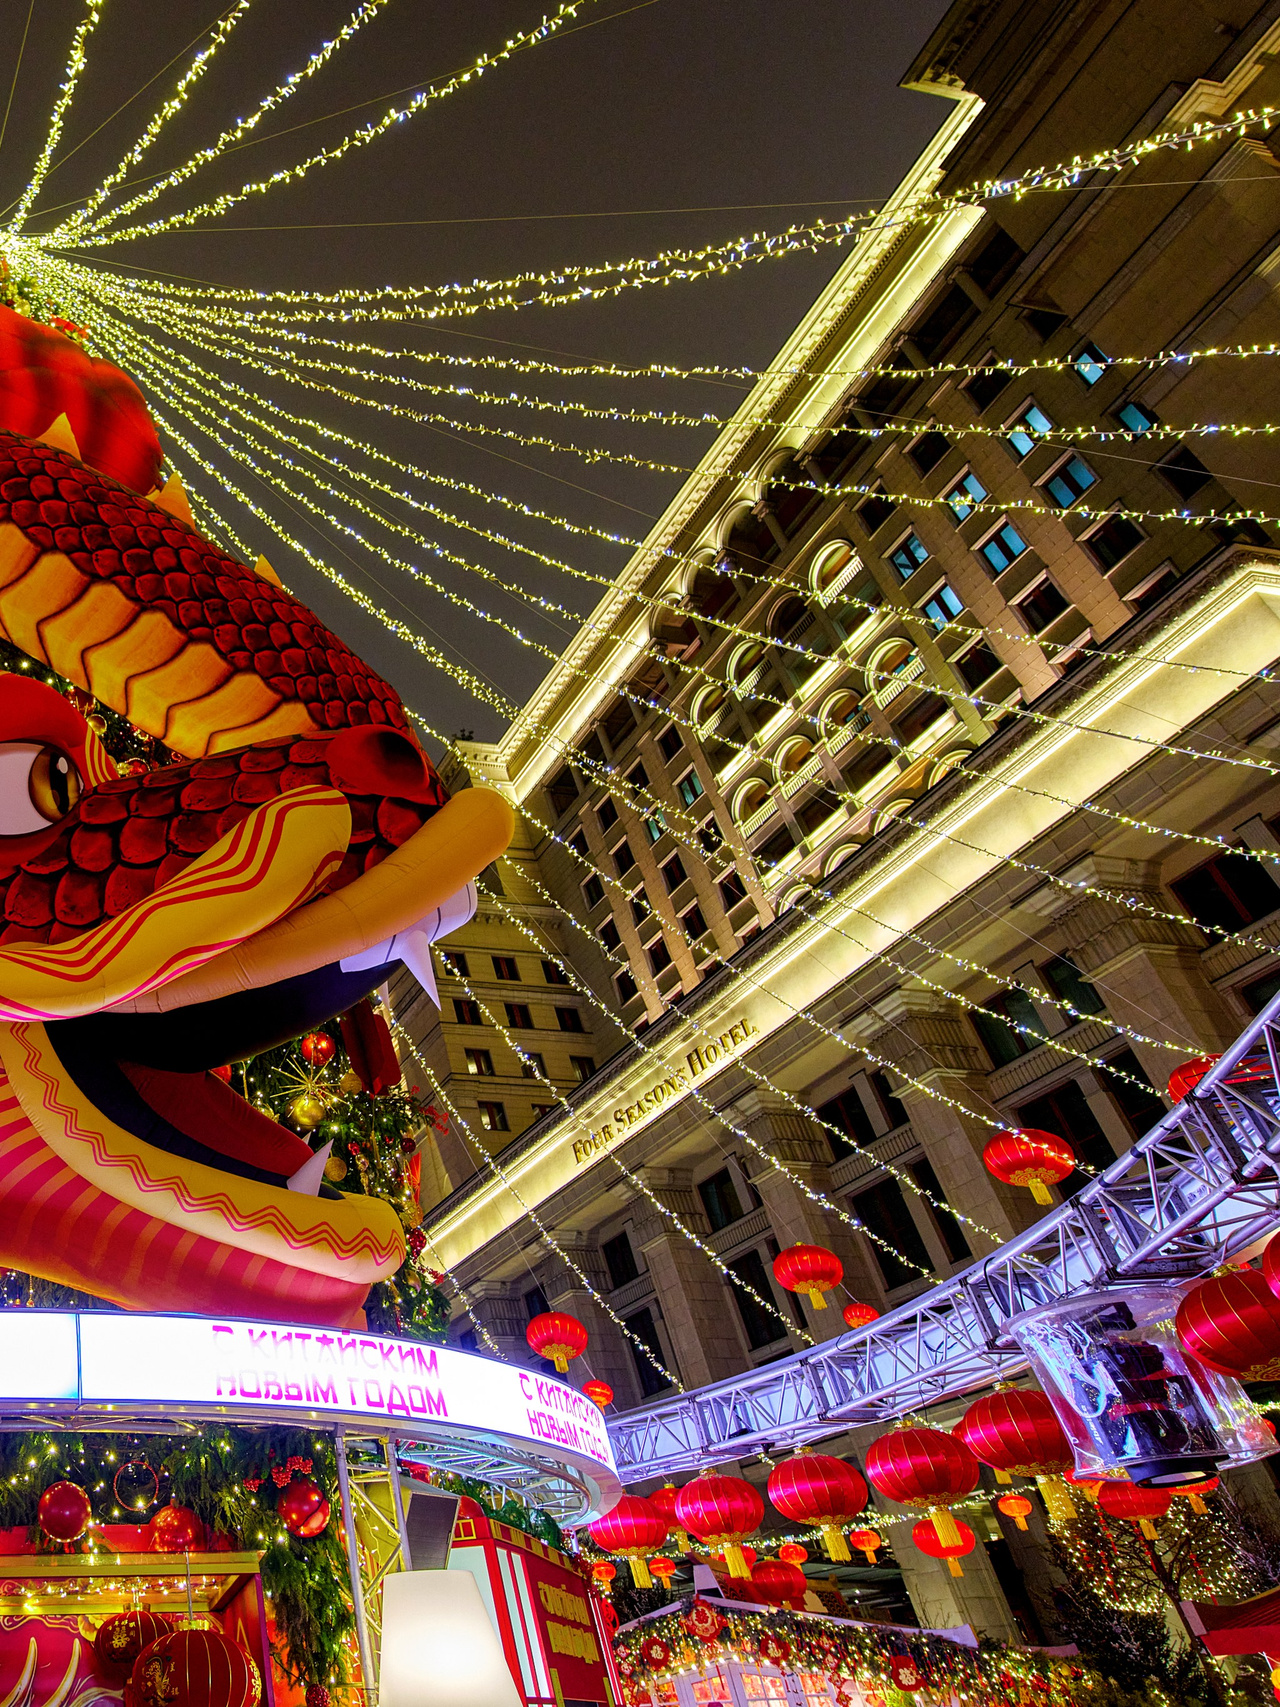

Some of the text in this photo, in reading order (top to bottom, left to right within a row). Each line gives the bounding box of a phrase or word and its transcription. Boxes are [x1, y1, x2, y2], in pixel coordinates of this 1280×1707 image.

[212, 1325, 440, 1379] С КИТАЙСКИМ
[216, 1369, 449, 1417] НОВЫМ ГОДОМ
[519, 1372, 533, 1401] С
[526, 1408, 582, 1450] НОВЫМ
